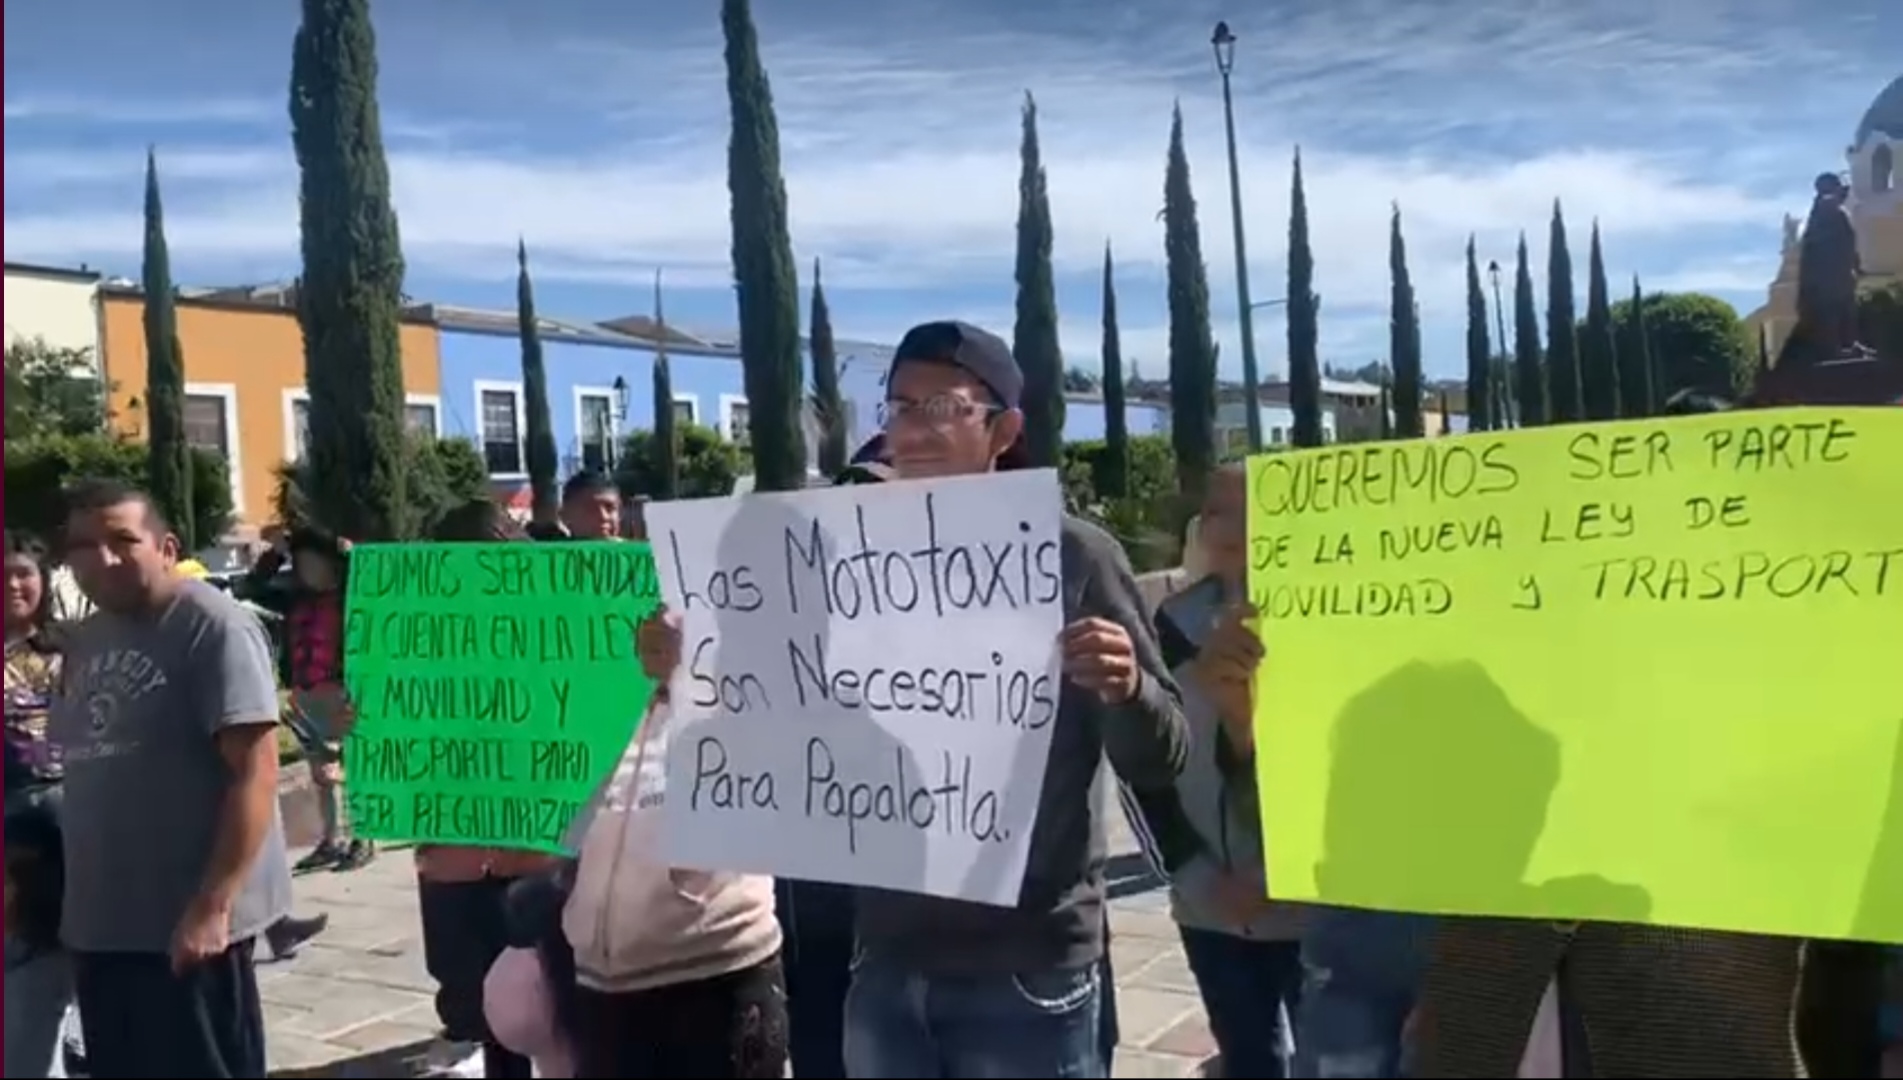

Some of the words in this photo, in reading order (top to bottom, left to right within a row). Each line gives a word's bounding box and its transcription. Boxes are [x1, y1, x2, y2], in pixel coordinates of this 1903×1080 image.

[1255, 443, 1520, 517] QUEREMOS
[1567, 431, 1674, 480] SER
[1703, 419, 1857, 472] PARTE
[669, 528, 763, 612] Las
[784, 492, 1060, 620] Mototaxis
[1250, 534, 1292, 571] DE
[1313, 532, 1355, 566] LA
[1379, 515, 1504, 560] NUEVA
[1684, 495, 1752, 530] DE
[353, 548, 462, 598] PEDIMOS
[477, 548, 536, 596] SER
[381, 611, 478, 662] CUENTA
[490, 613, 528, 661] EN
[539, 614, 574, 664] LA
[588, 612, 643, 663] LEY
[381, 674, 531, 724] MOVILIDAD
[552, 676, 571, 730] Y
[690, 637, 771, 713] Son
[788, 633, 1055, 730] Necesarias
[349, 732, 514, 783] TRANSPORTE
[350, 791, 395, 833] SER
[690, 736, 779, 812] Para
[805, 737, 1011, 854] Papalotla.
